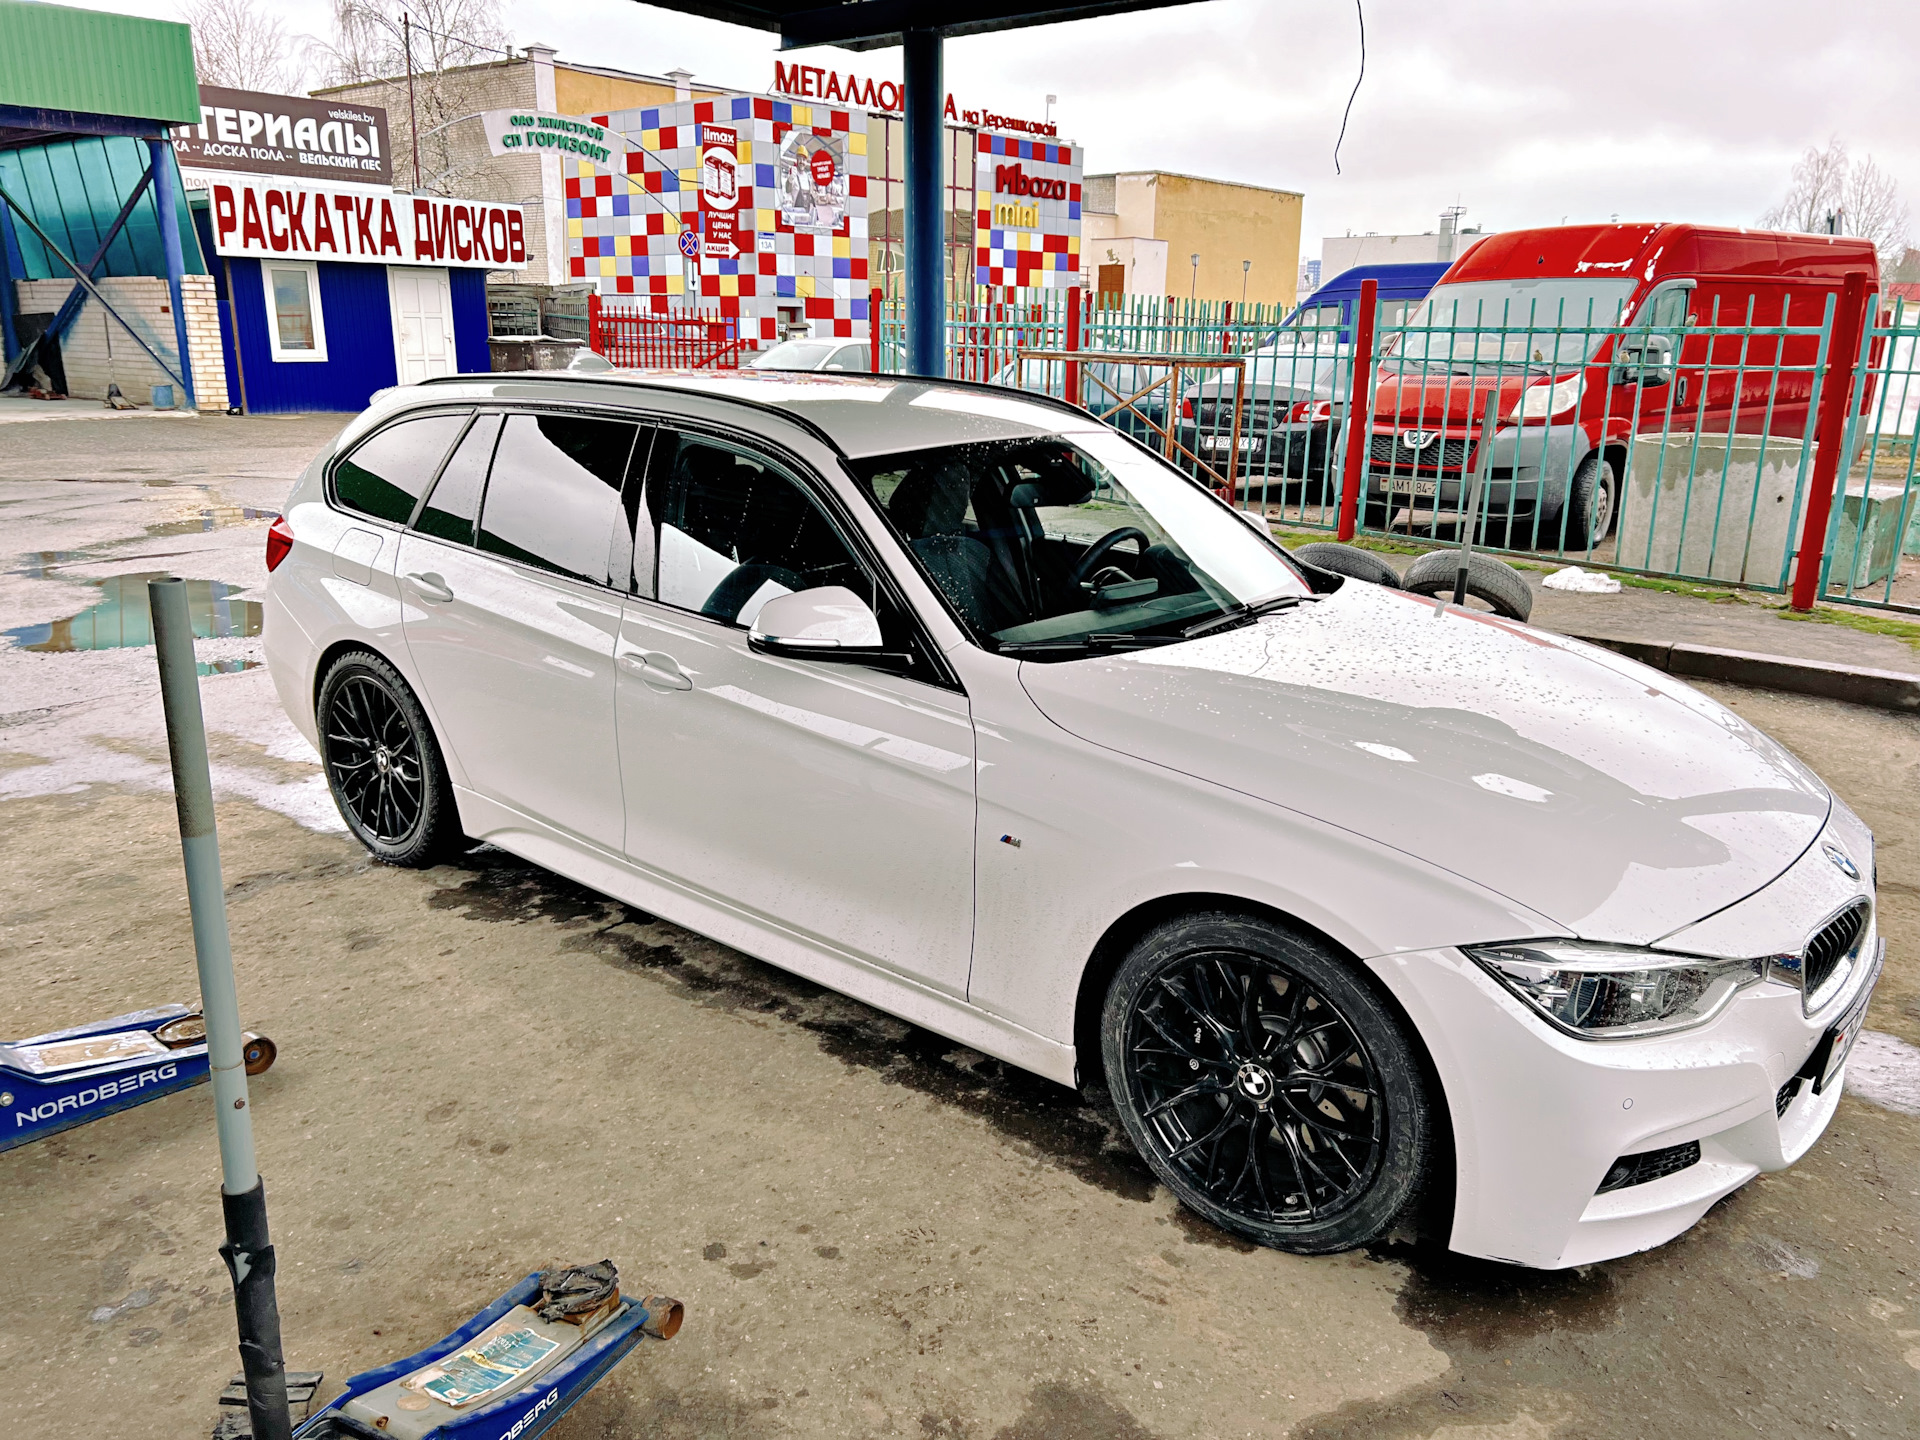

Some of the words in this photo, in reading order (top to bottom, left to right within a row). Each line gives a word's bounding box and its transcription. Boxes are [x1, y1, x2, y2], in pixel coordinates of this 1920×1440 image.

[775, 60, 958, 121] МЕТАЛЛОА
[962, 109, 980, 125] на
[981, 108, 1057, 137] Терешковой
[328, 109, 375, 125] velskiles.by
[510, 115, 535, 127] ОАО
[538, 116, 604, 141] ЖИЛСТРОЙ
[703, 127, 735, 144] ilmax
[203, 142, 249, 158] ДОСКА
[250, 148, 285, 162] ПОЛА
[503, 134, 522, 148] СП
[527, 131, 611, 162] ГОРИЗОНТ
[299, 152, 358, 169] ВЕЛЬСКИЙ
[360, 159, 382, 171] ЛЕС
[707, 210, 736, 221] ЛУЧШИЕ
[995, 199, 1040, 229] mini
[213, 184, 403, 257] РАСКАТКА
[413, 199, 526, 264] ДИСКОВ
[712, 221, 732, 231] ЦЕНЫ
[718, 231, 732, 240] НАС
[706, 244, 730, 254] АКЦИЯ
[15, 1062, 178, 1127] NORDBERG
